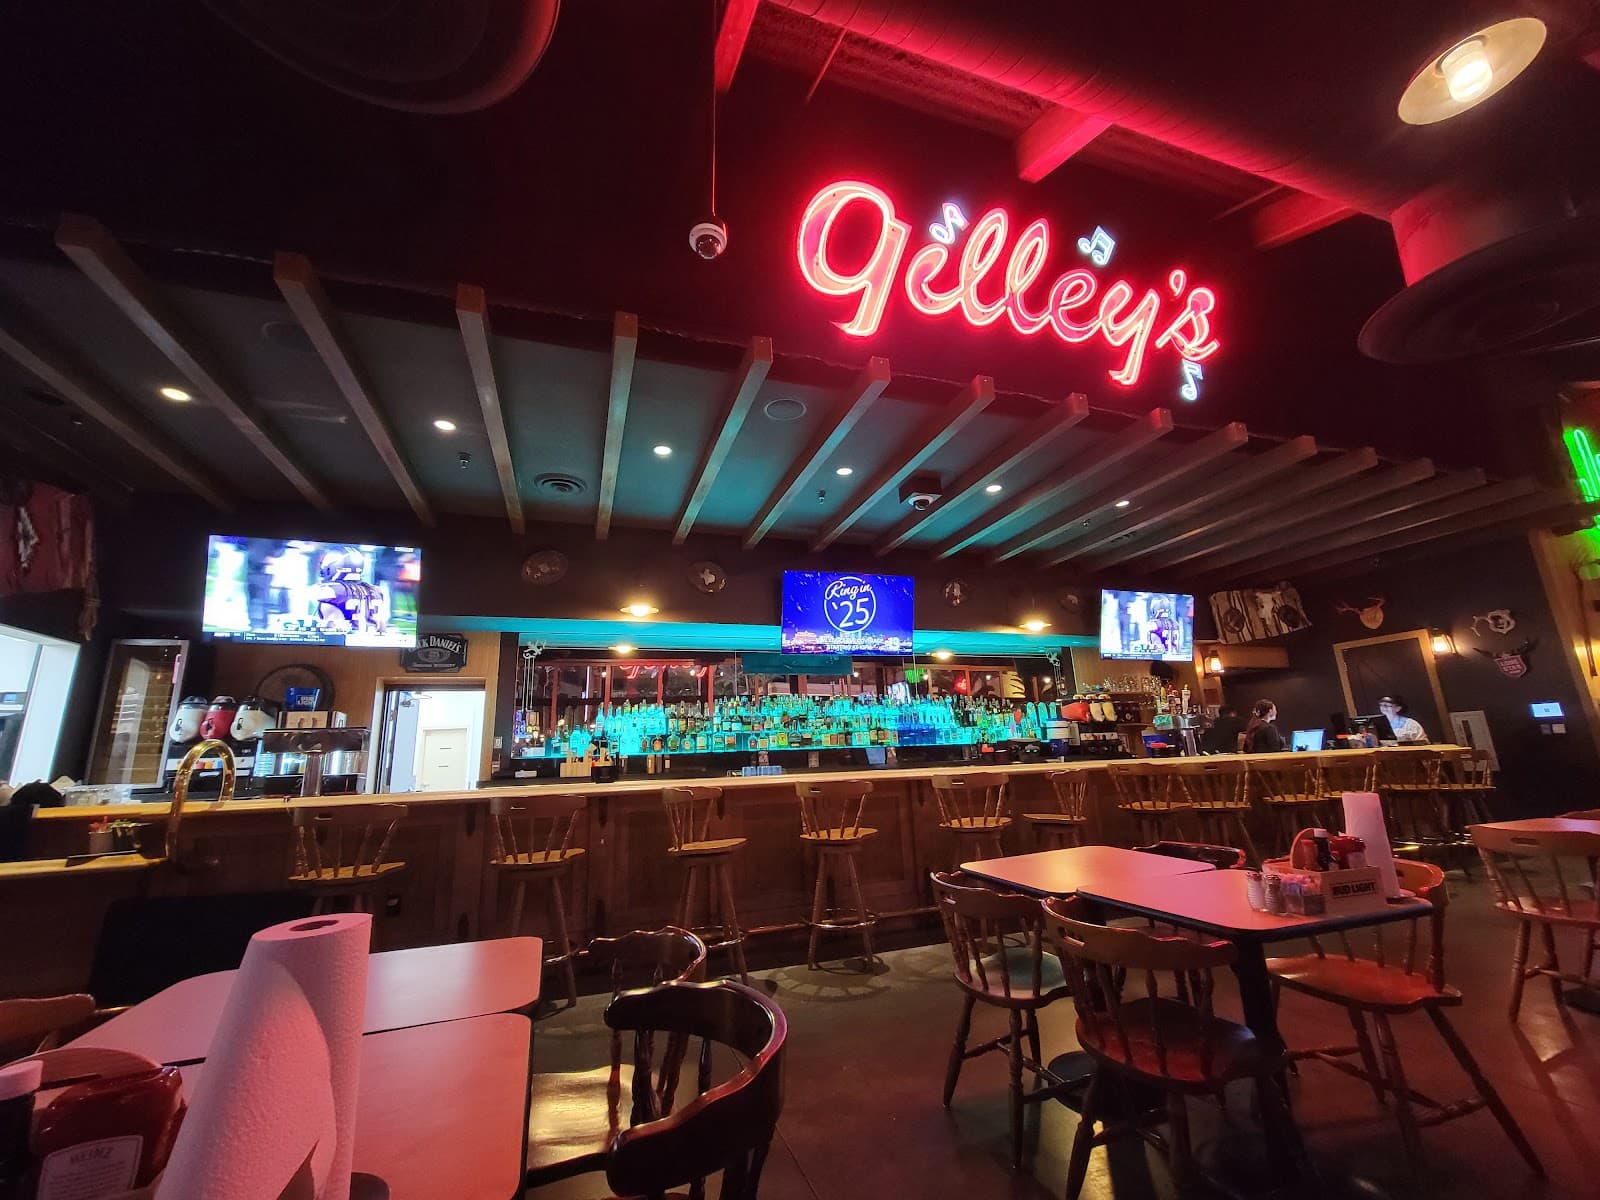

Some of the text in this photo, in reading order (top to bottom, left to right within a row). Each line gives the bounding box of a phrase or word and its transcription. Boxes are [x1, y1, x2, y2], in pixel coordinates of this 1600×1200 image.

[825, 580, 872, 600] Ring in
[831, 597, 869, 627] '25
[429, 635, 462, 653] DANIEL'S
[1352, 882, 1376, 894] LIGHT
